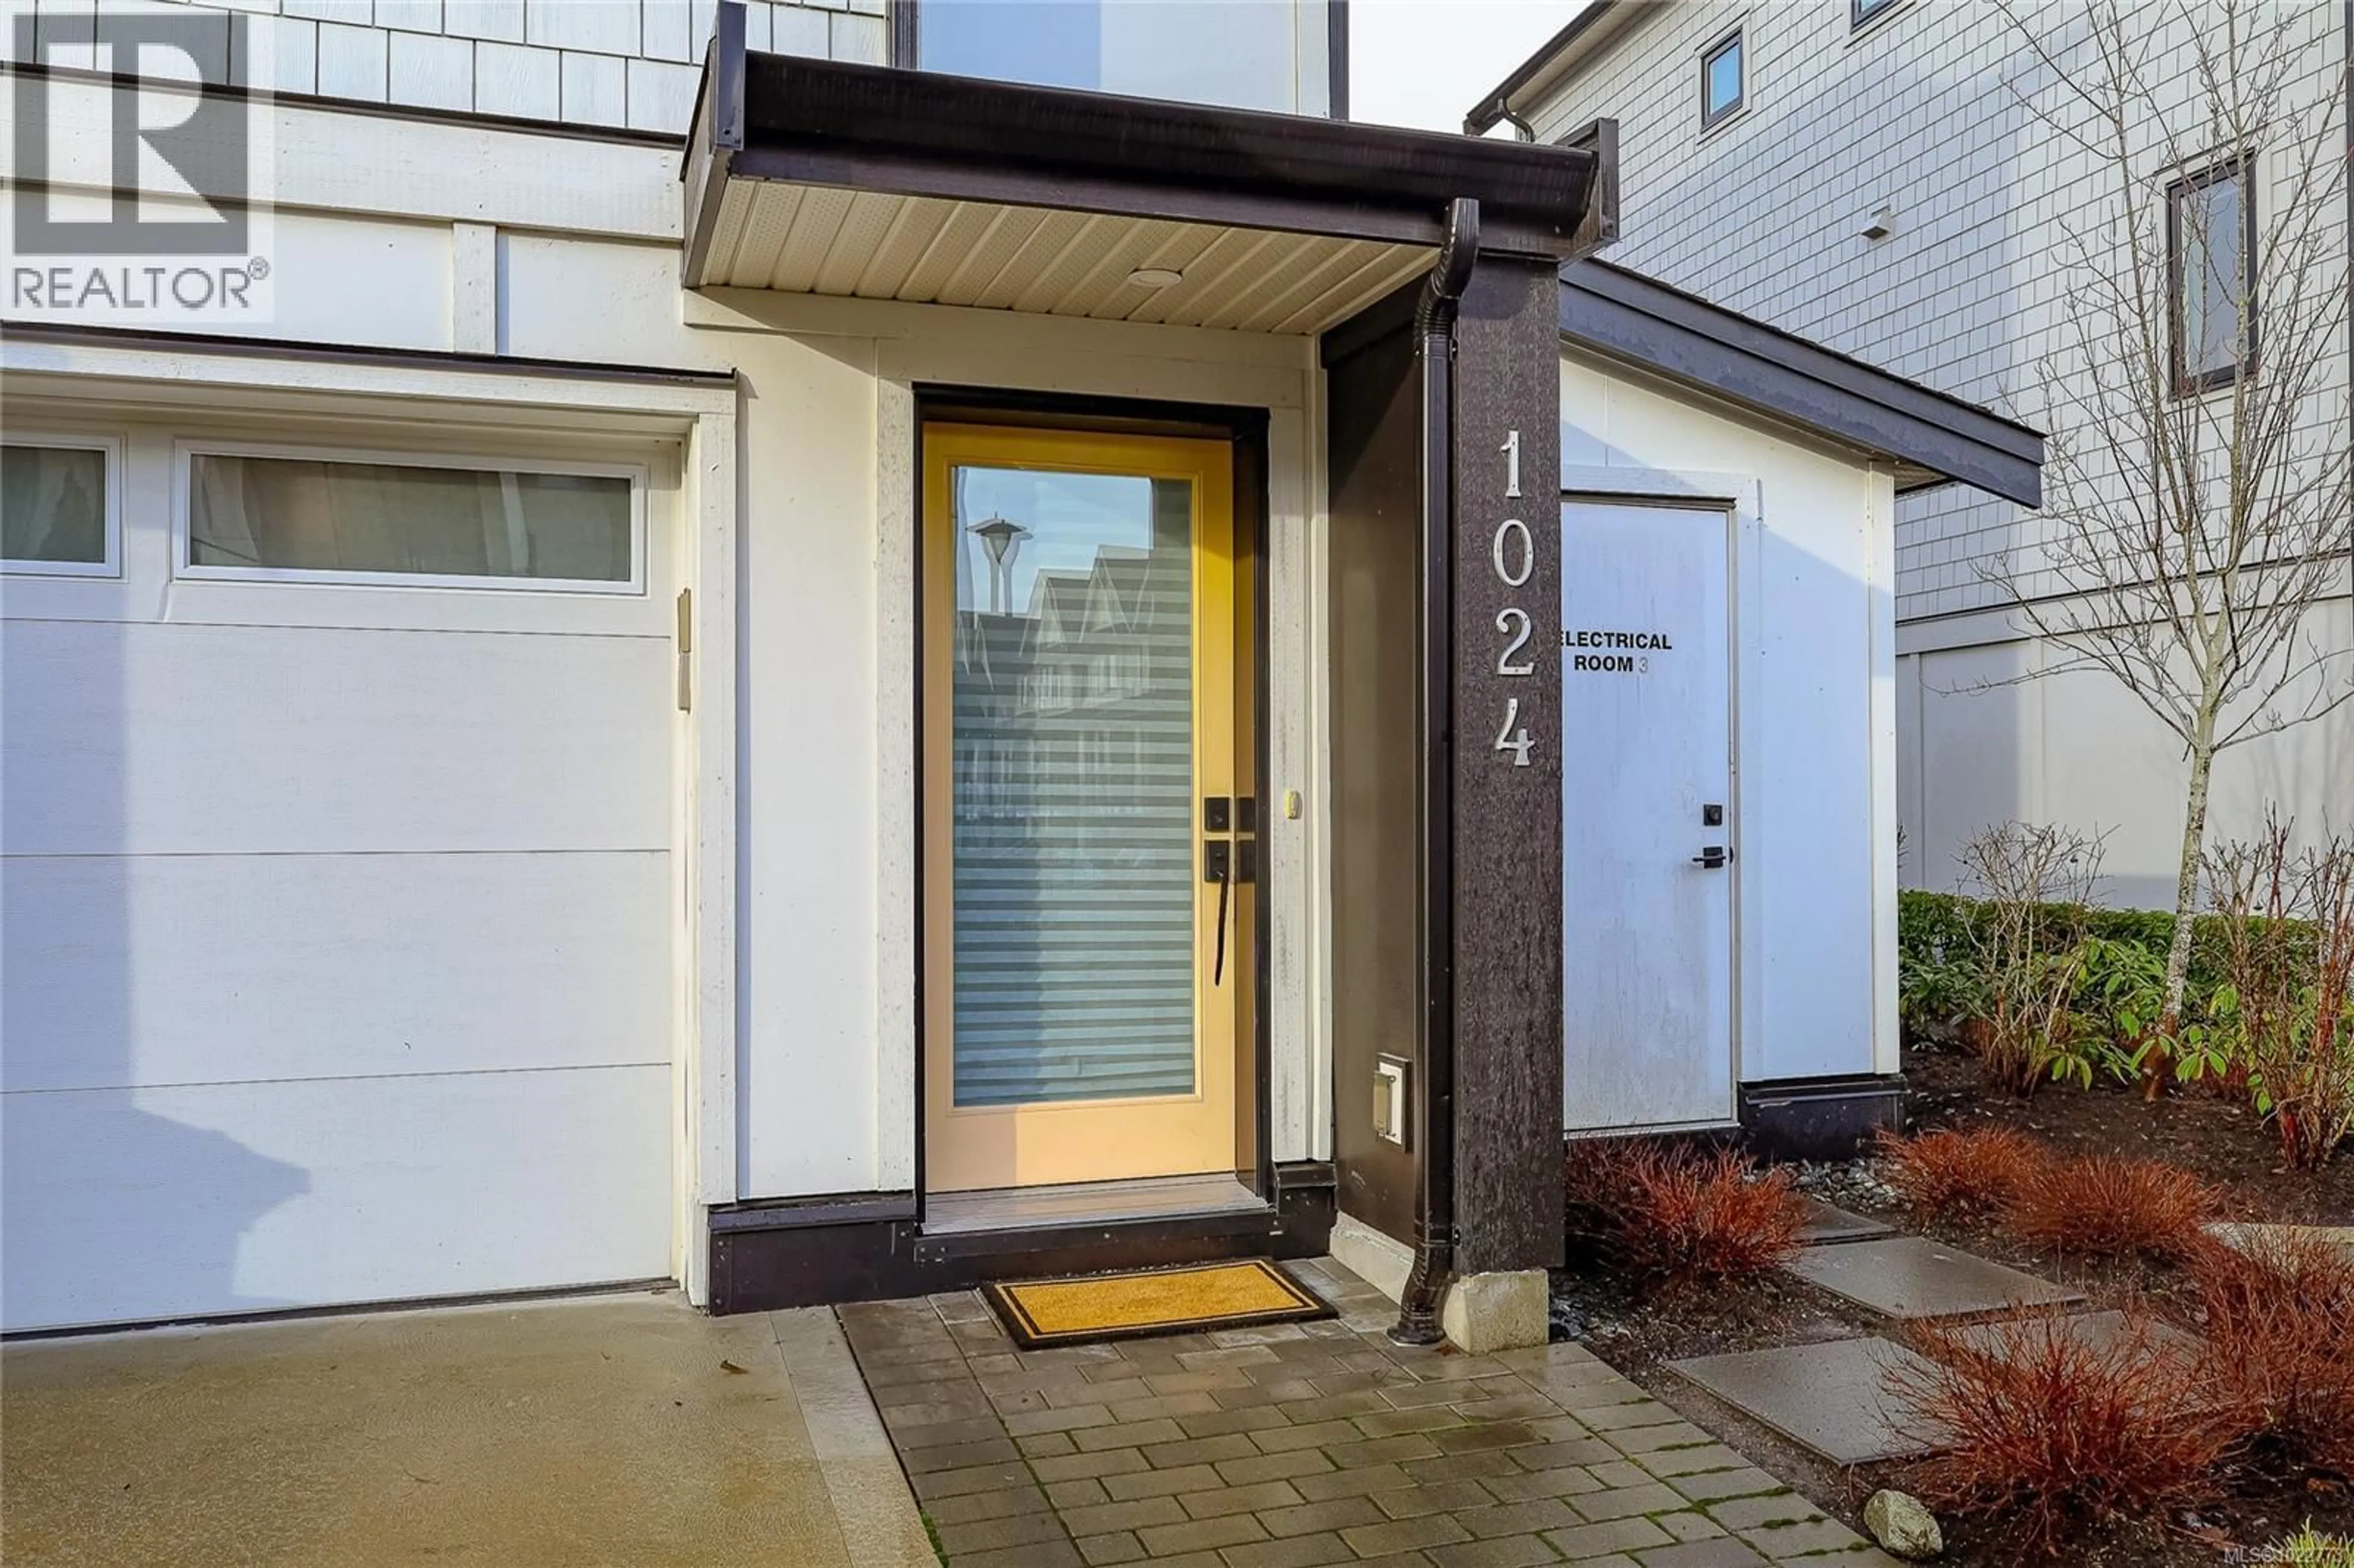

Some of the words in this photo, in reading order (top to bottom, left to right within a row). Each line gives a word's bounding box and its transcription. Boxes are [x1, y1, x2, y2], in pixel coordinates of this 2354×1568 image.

[1493, 430, 1535, 766] 1024
[1574, 655, 1634, 672] ROOM
[1639, 657, 1649, 673] 3
